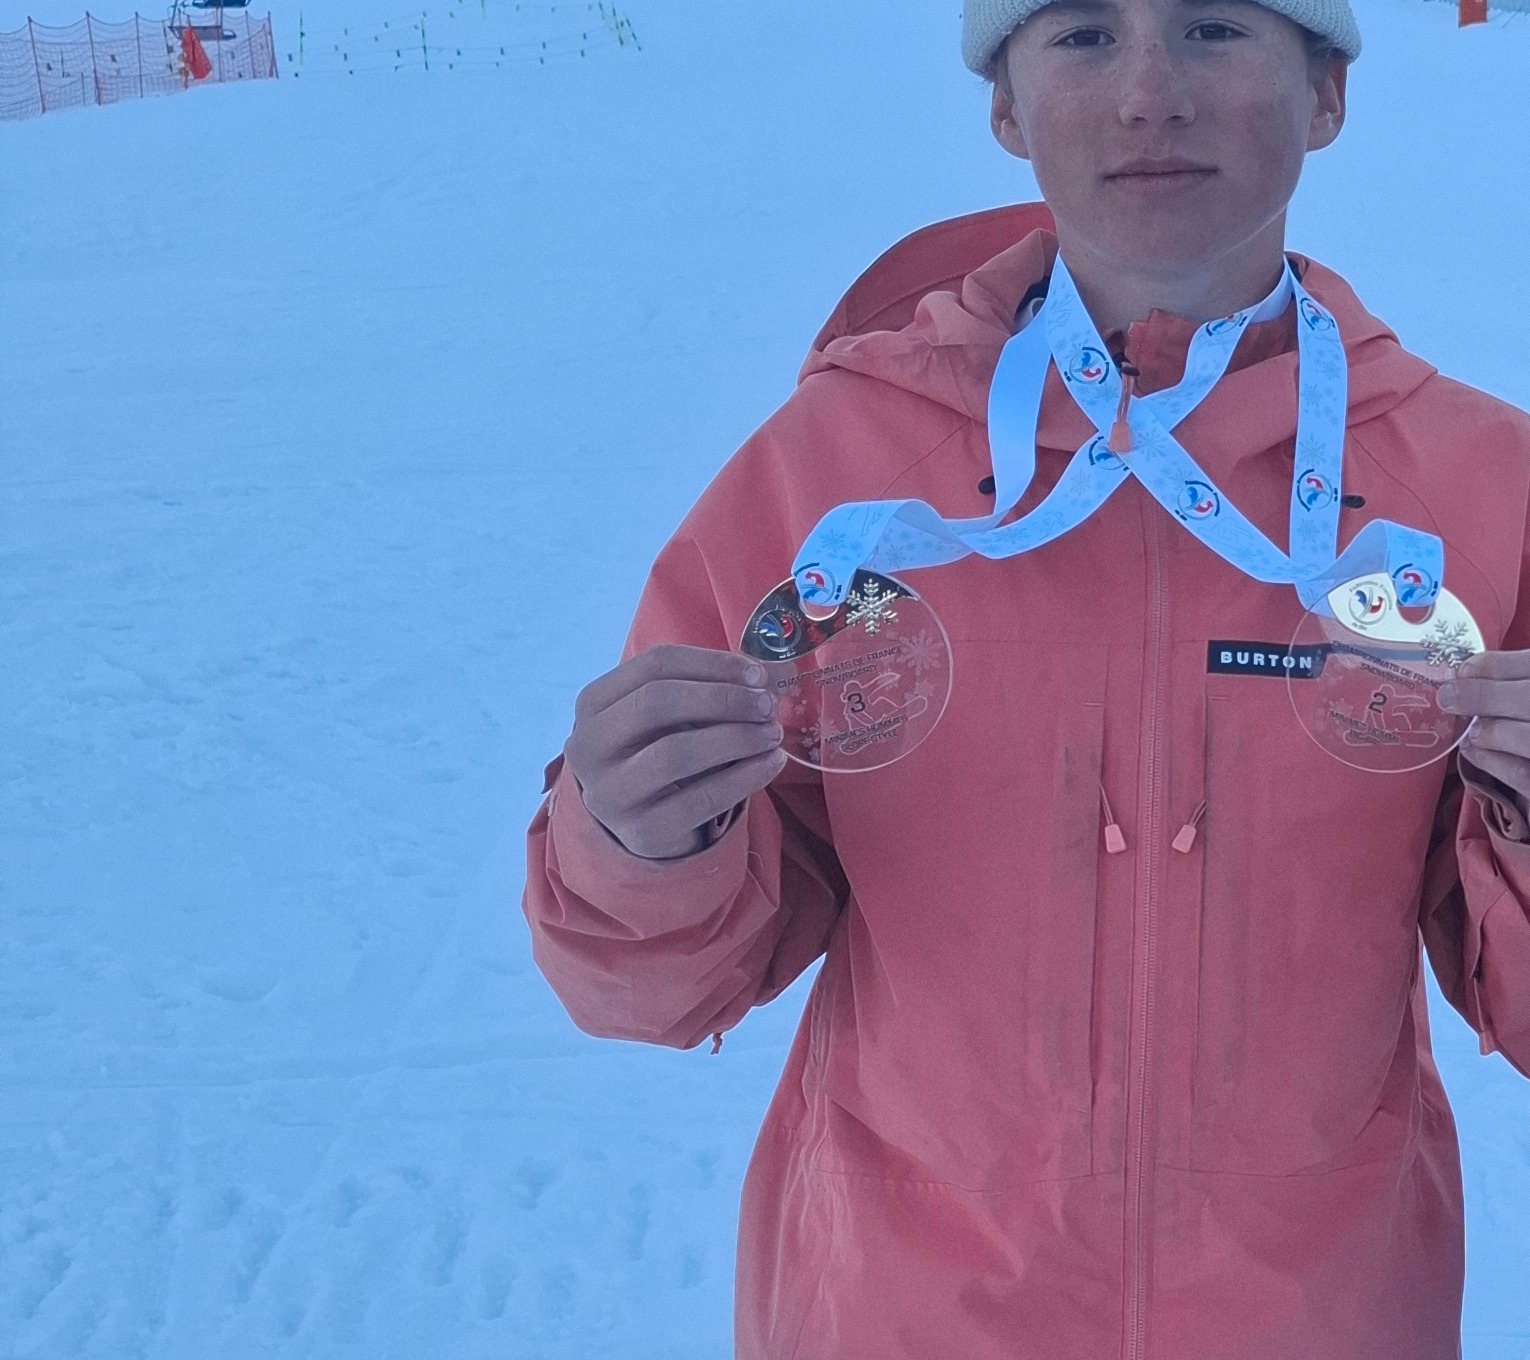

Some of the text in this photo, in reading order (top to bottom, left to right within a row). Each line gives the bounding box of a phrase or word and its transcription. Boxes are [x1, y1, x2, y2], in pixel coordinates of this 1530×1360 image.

[1220, 651, 1312, 669] BURTON
[1412, 673, 1442, 690] FRANC
[848, 693, 866, 713] 3
[1368, 692, 1387, 713] 2
